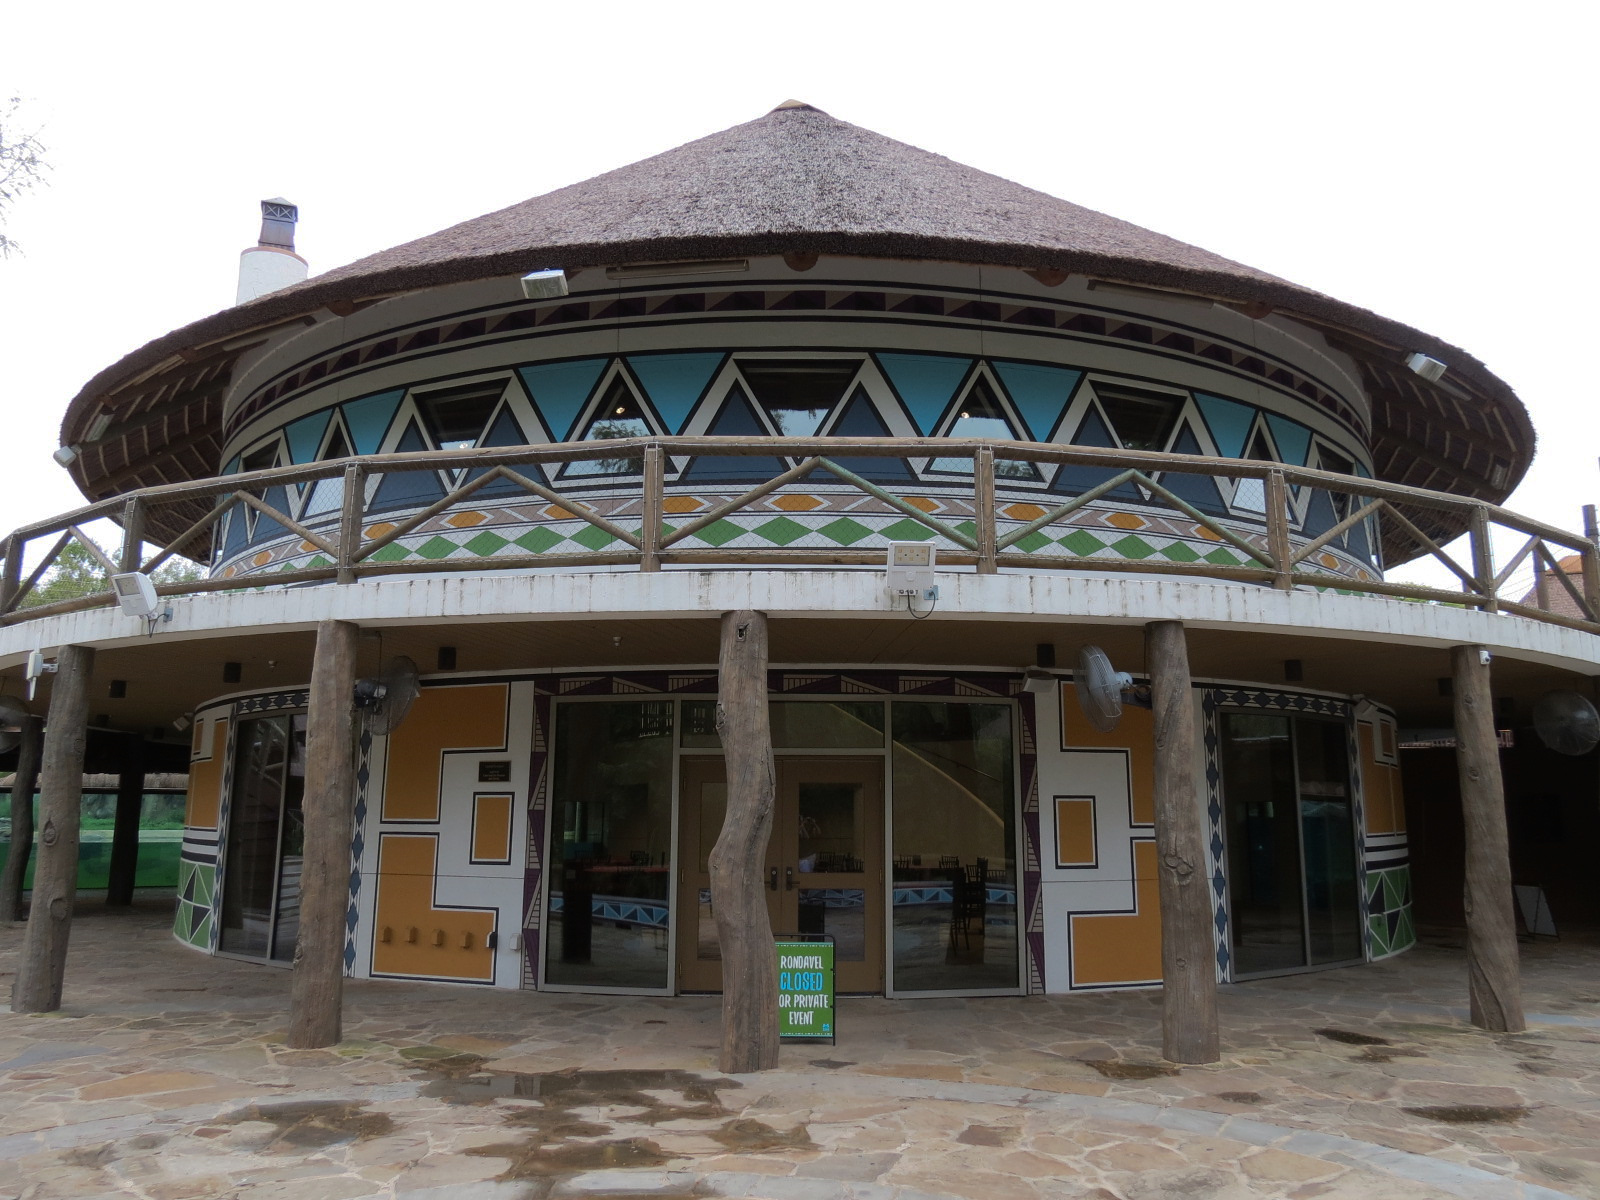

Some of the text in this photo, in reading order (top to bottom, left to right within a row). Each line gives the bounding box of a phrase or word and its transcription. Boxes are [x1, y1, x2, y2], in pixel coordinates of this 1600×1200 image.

[780, 955, 823, 969] RONDAVEL
[780, 972, 823, 991] CLOSED
[778, 994, 828, 1008] OR PRIVATE
[789, 1011, 814, 1025] EVENT
